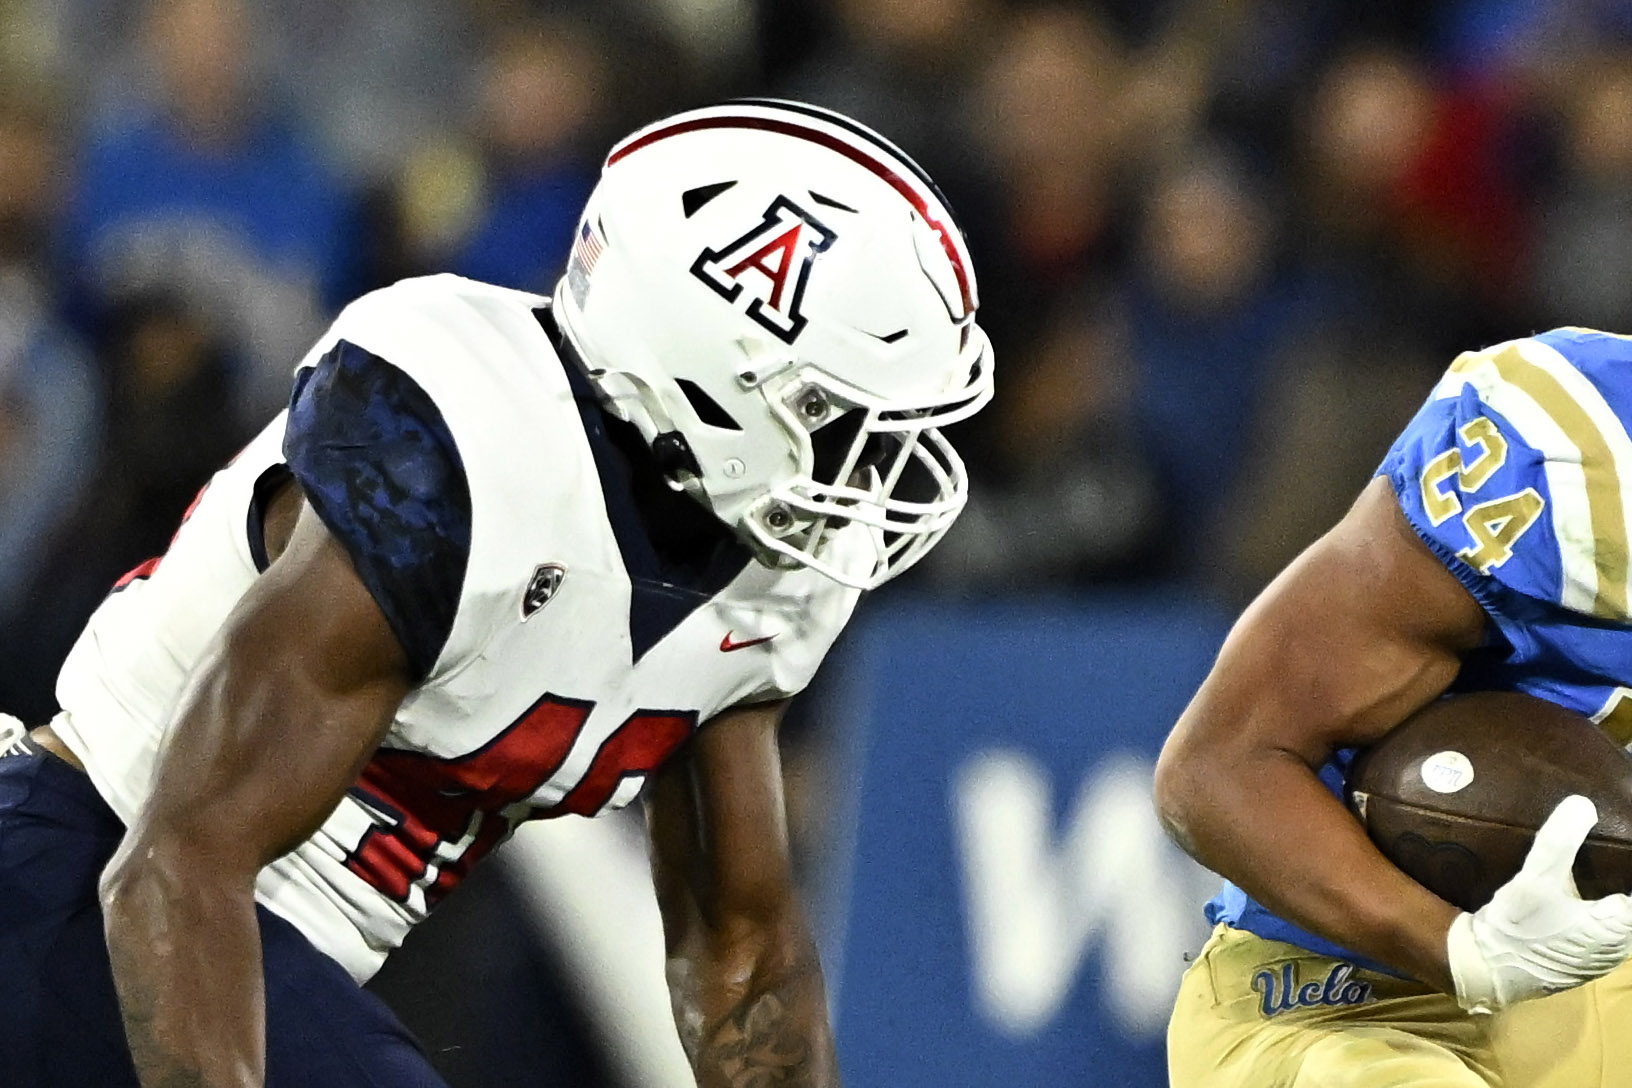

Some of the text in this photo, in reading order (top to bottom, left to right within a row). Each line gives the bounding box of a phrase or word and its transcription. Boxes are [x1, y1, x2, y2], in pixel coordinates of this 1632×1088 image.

[689, 194, 839, 346] A
[1420, 415, 1546, 577] 24
[1252, 961, 1377, 1018] Ucla
